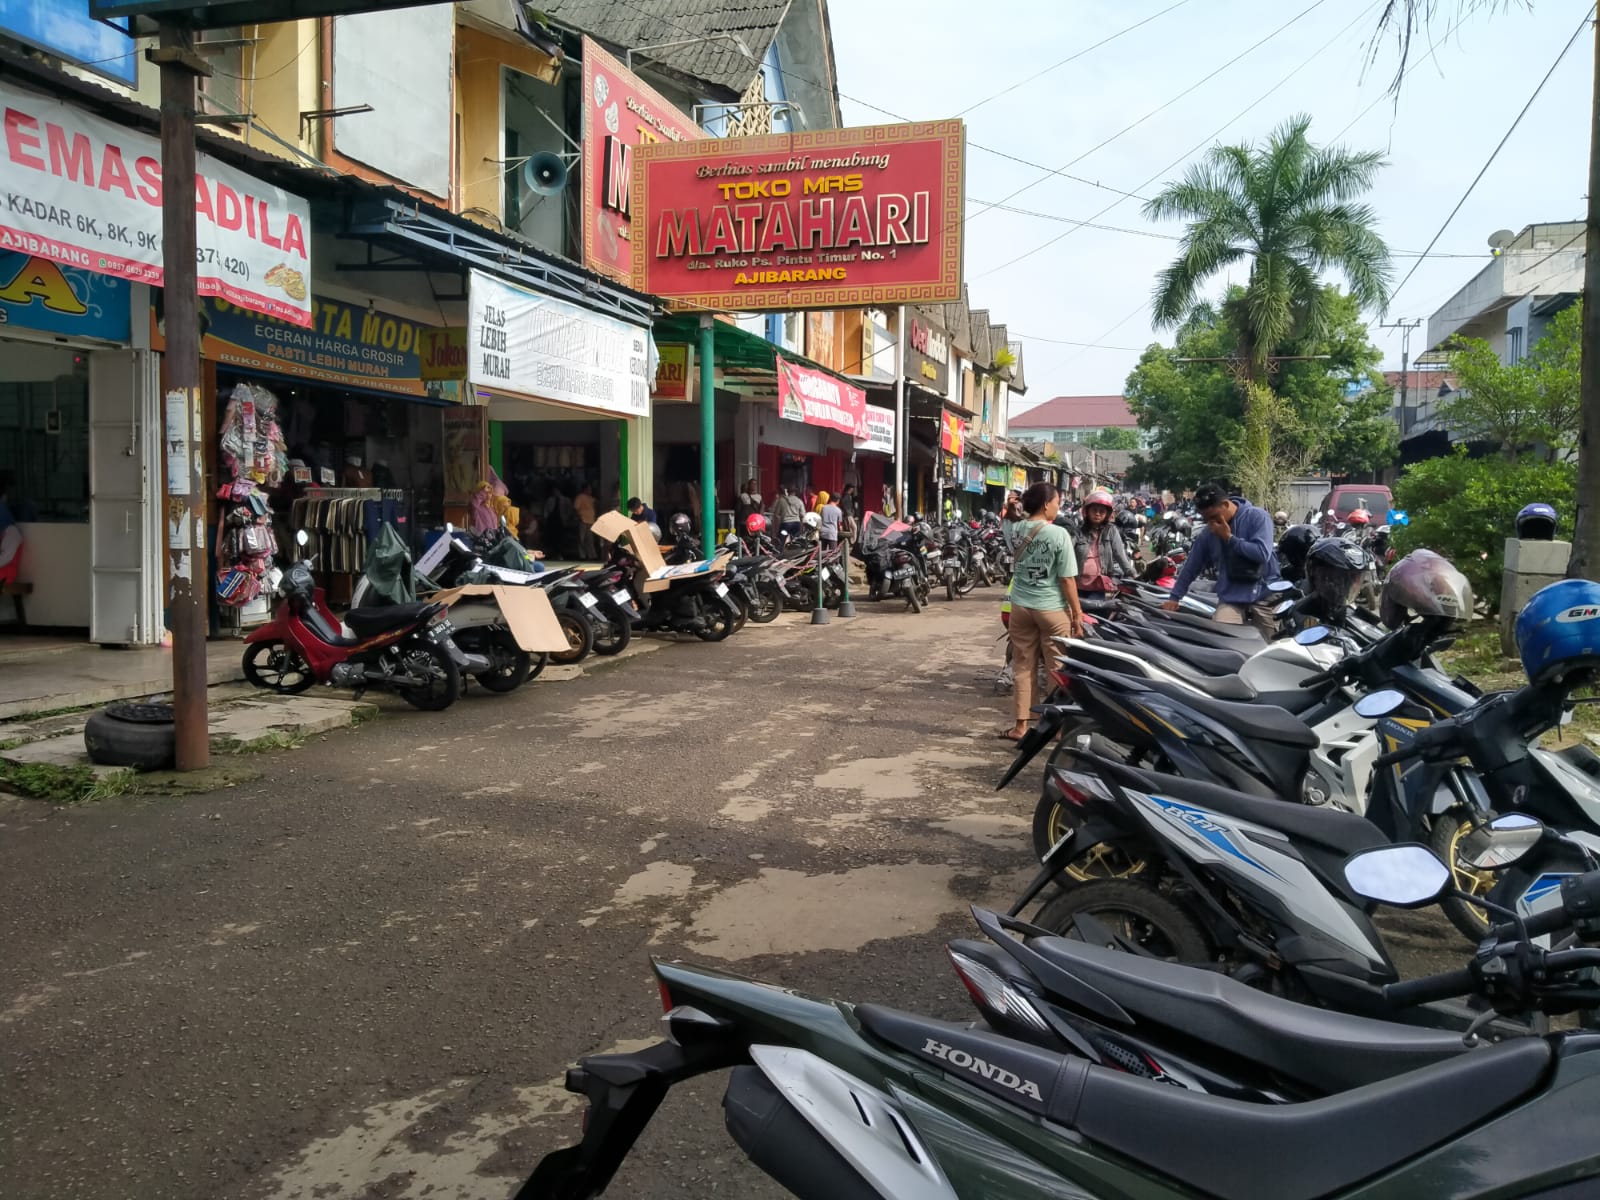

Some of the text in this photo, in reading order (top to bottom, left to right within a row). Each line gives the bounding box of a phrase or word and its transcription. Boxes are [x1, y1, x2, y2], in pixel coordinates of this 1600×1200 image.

[4, 107, 163, 208] EMAS
[696, 151, 890, 178] Berhias sambil menabung
[718, 173, 864, 200] TOKO MAS
[8, 193, 72, 231] KADAR
[76, 214, 103, 240] 6K,
[107, 223, 133, 249] 8K,
[656, 191, 931, 258] MATAHARI
[2, 232, 90, 266] AJIBARANG
[714, 257, 748, 269] Ruko
[752, 256, 773, 267] Ps.
[776, 255, 813, 266] Pintu
[816, 253, 858, 264] Timur
[861, 250, 885, 261] No.
[889, 249, 897, 259] 1
[734, 266, 848, 285] AJIBARANG
[483, 304, 506, 328] JELAS
[254, 324, 405, 367] ECERAN HARGA GROSIR
[480, 325, 507, 354] LEBIH
[219, 353, 262, 368] RUKO
[309, 370, 349, 383] PASAR
[351, 377, 414, 394] AJIBARANG
[266, 343, 390, 378] PASTI LEBIH MURAH
[482, 352, 511, 380] MURAH
[921, 1037, 1044, 1102] HONDA
